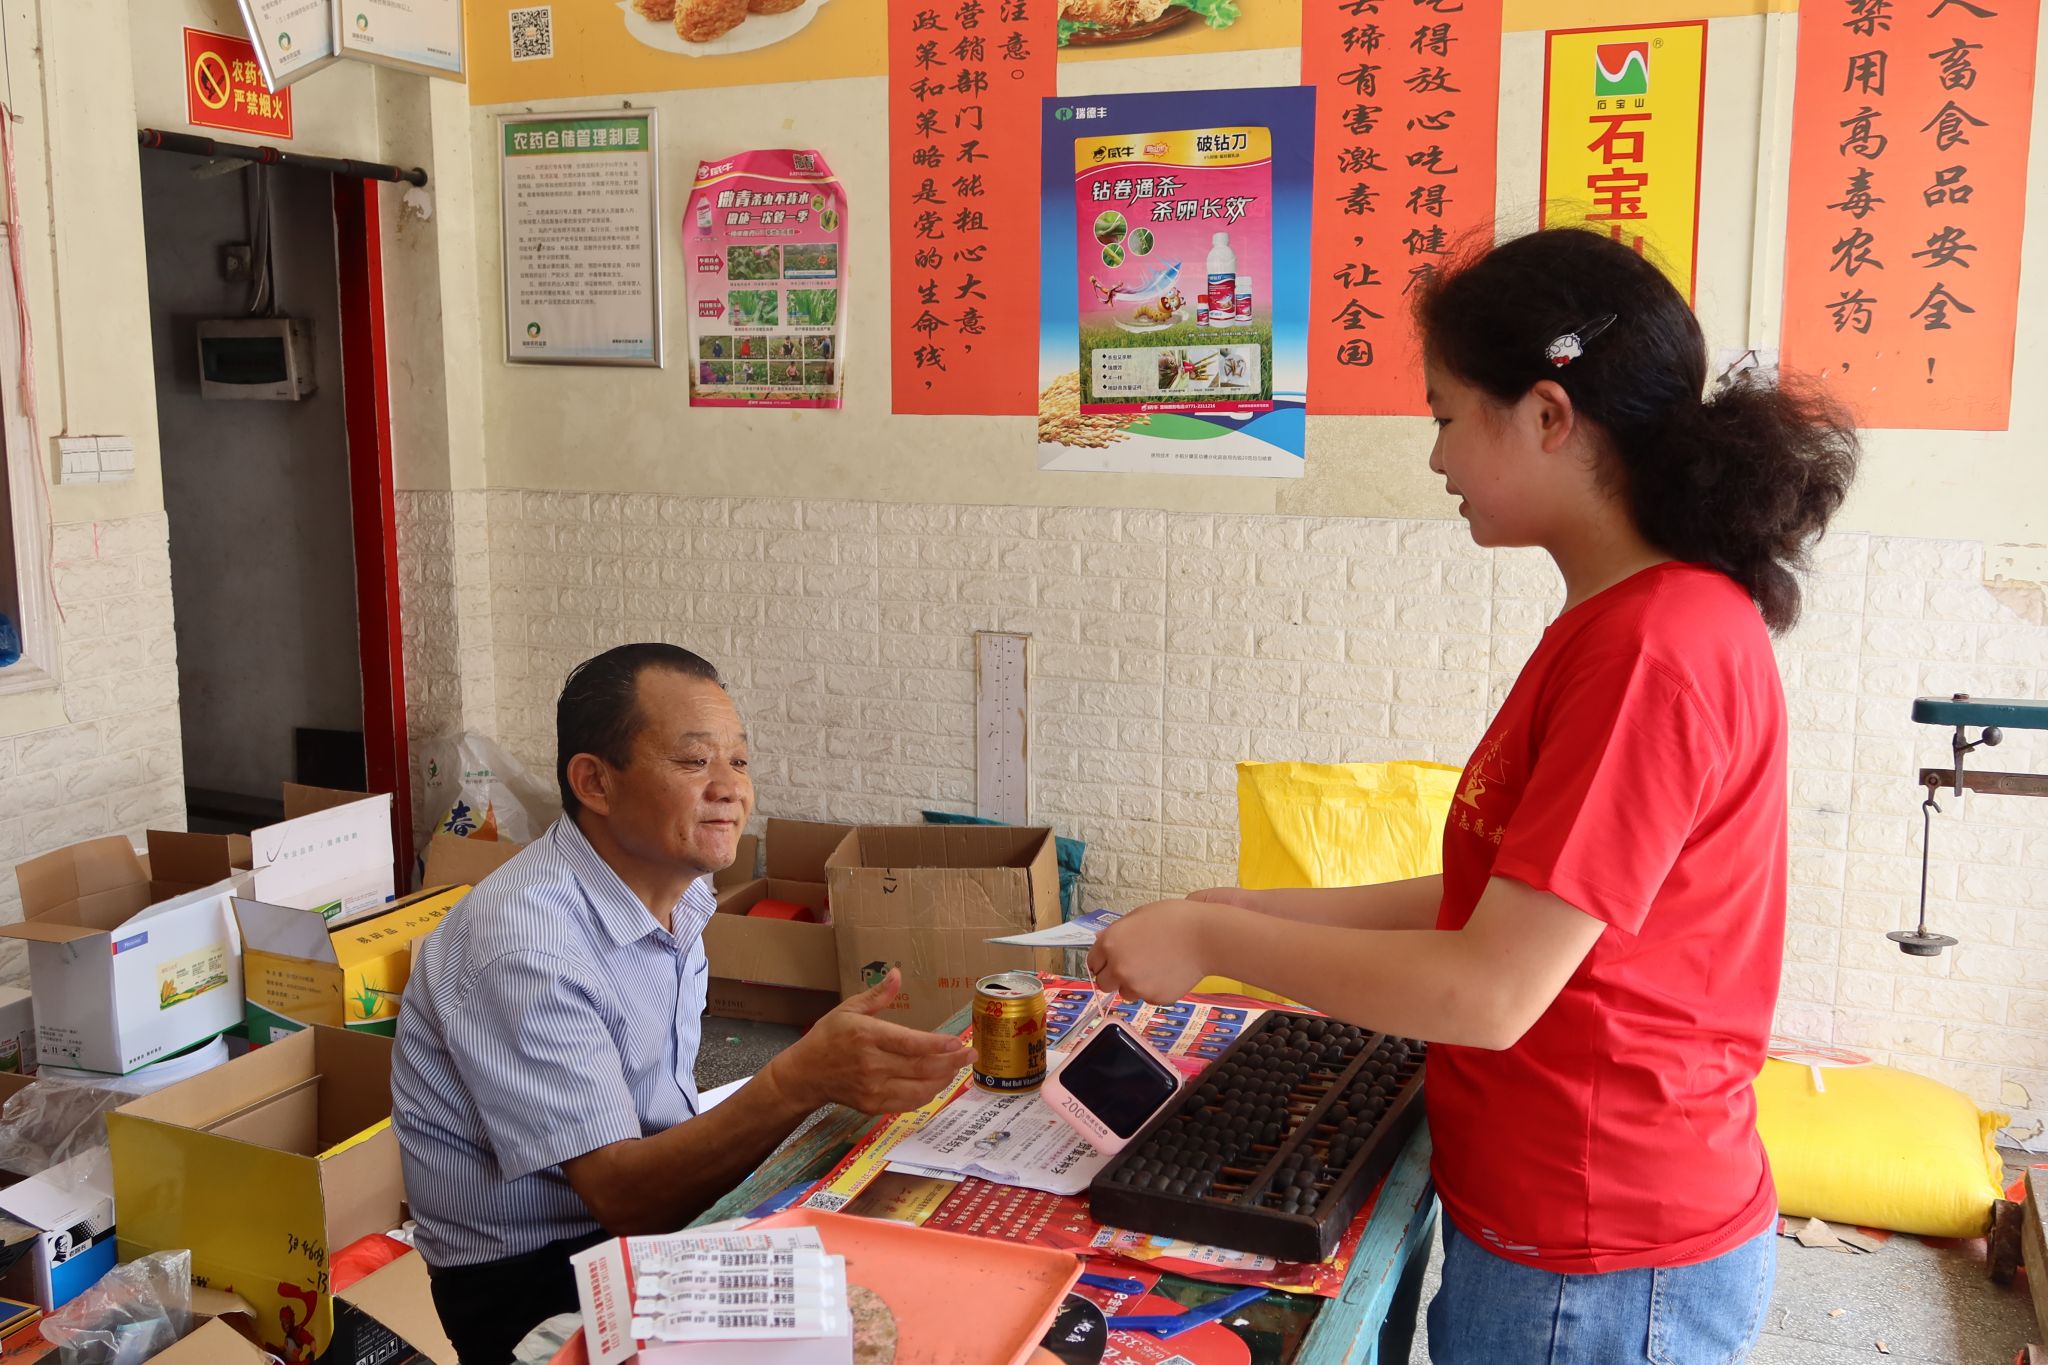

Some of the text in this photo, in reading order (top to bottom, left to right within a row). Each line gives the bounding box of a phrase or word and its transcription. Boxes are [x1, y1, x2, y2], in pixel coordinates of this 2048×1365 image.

[233, 88, 284, 120] 严禁烟火
[1075, 107, 1108, 119] 瑞德丰
[1597, 98, 1645, 110] 石宝山
[514, 127, 640, 150] 农药仓储管理制度
[1196, 133, 1248, 153] 破钻刀
[910, 9, 950, 390] 政策和策略是党的生命线，
[1091, 175, 1186, 208] 钻卷通杀
[1151, 196, 1257, 225] 杀卵长效
[443, 799, 477, 837] 春
[1452, 803, 1506, 846] 志愿者
[893, 992, 910, 1002] NG
